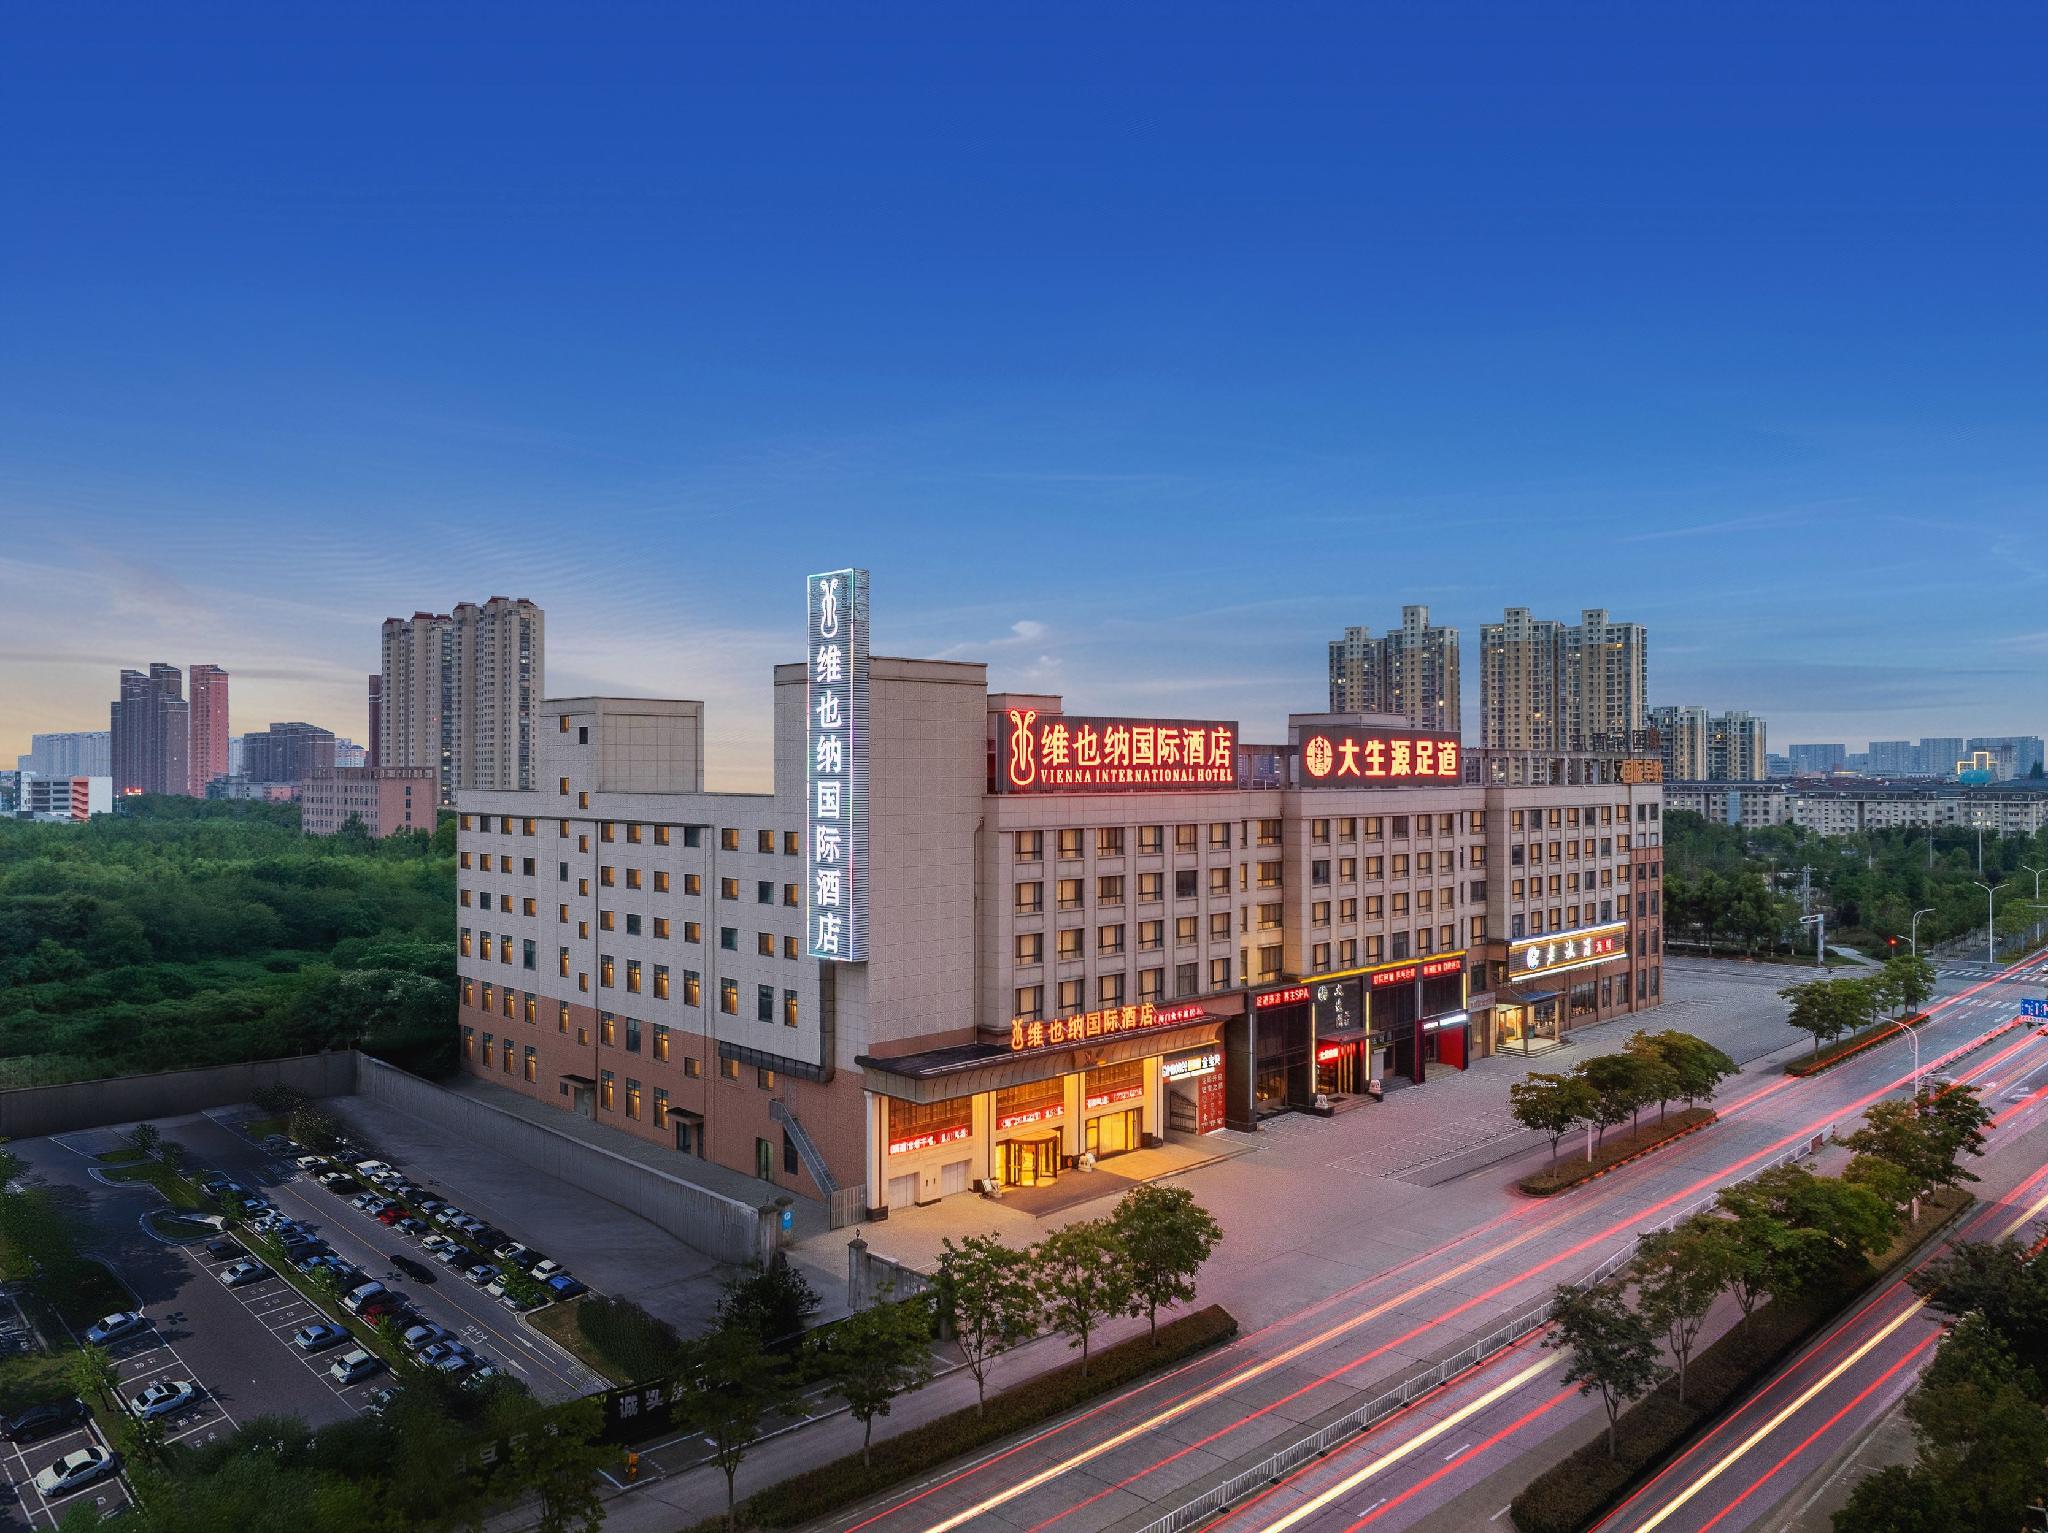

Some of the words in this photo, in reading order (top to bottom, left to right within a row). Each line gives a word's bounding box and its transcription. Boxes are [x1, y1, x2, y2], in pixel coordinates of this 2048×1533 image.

[1040, 725, 1232, 767] 维也纳国际酒店
[1337, 738, 1458, 777] 大生源足道
[1041, 769, 1092, 783] VIENNA
[1095, 769, 1196, 783] INTERNATIONAL
[1197, 769, 1233, 783] HOTEL
[815, 644, 843, 953] 维也纳国际酒店
[1027, 1003, 1155, 1048] 维也纳国际酒店
